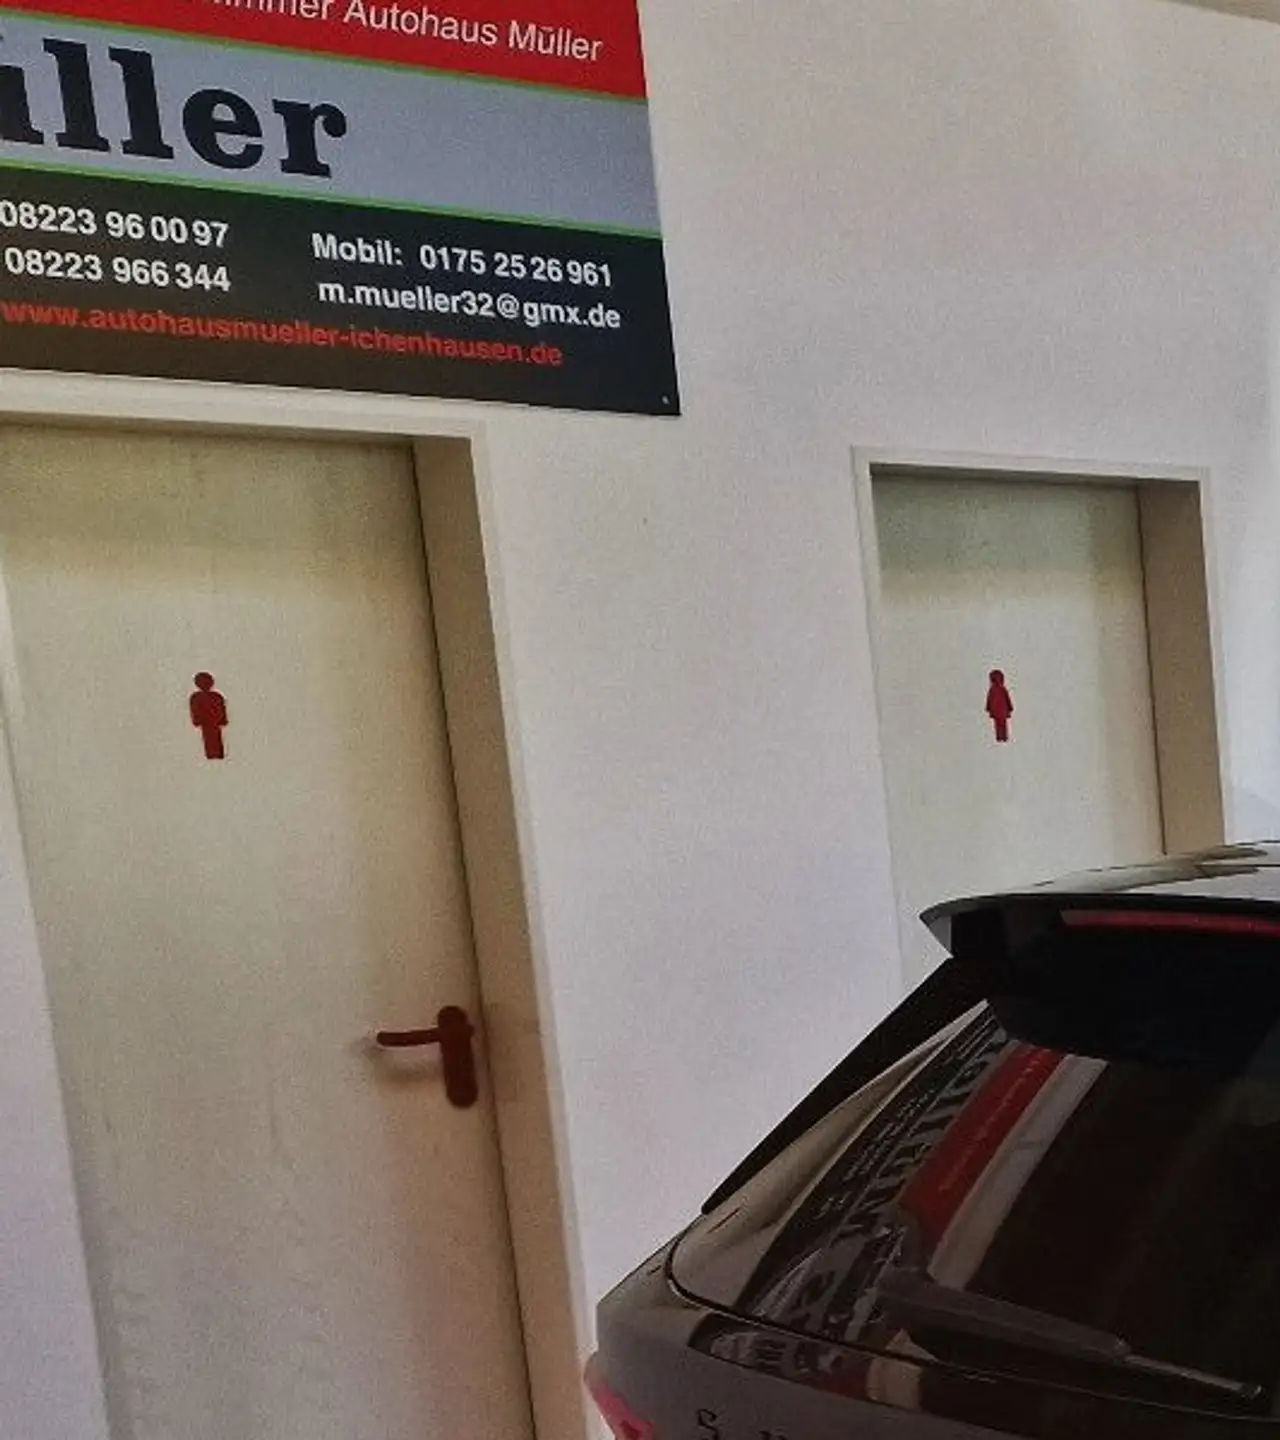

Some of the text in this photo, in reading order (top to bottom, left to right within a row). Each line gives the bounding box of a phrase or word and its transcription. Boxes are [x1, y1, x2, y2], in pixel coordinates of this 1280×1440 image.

[343, 0, 499, 46] Autohaus
[508, 20, 602, 61] Müller
[0, 200, 98, 235] 08223
[4, 247, 103, 281] 08223
[311, 233, 404, 266] Mobil:
[420, 244, 487, 274] 0175
[318, 281, 621, 328] m.mueller32@gmx.de
[1, 302, 564, 366] www.autohausmueller-ichenhausen.de
